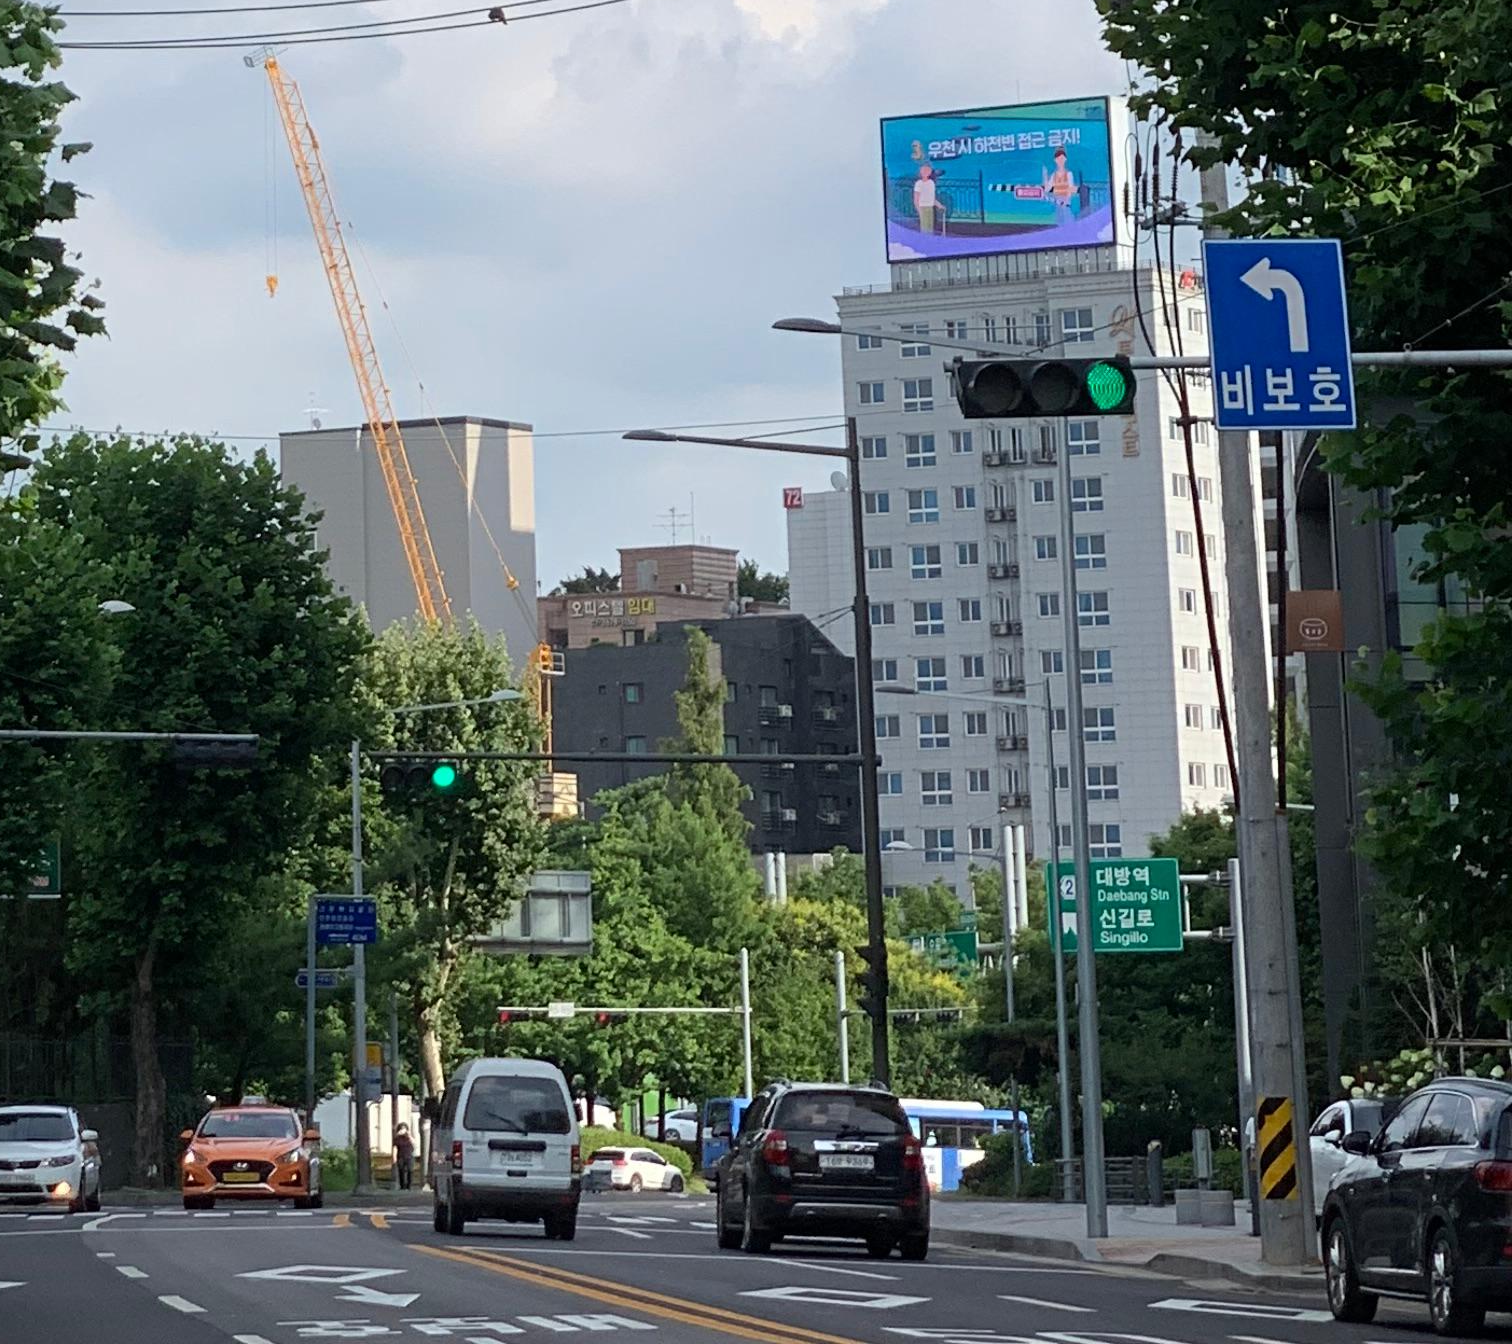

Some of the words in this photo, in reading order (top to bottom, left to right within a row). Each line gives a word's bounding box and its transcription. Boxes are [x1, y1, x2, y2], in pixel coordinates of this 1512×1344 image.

[1221, 364, 1347, 416] 비보호
[786, 490, 800, 505] 72
[571, 599, 624, 617] 오피스텔
[628, 597, 656, 615] 임대
[1095, 866, 1150, 887] 대방역
[1098, 889, 1148, 904] Daebang
[1099, 908, 1155, 929] 신길로
[1100, 932, 1149, 947] Singillo
